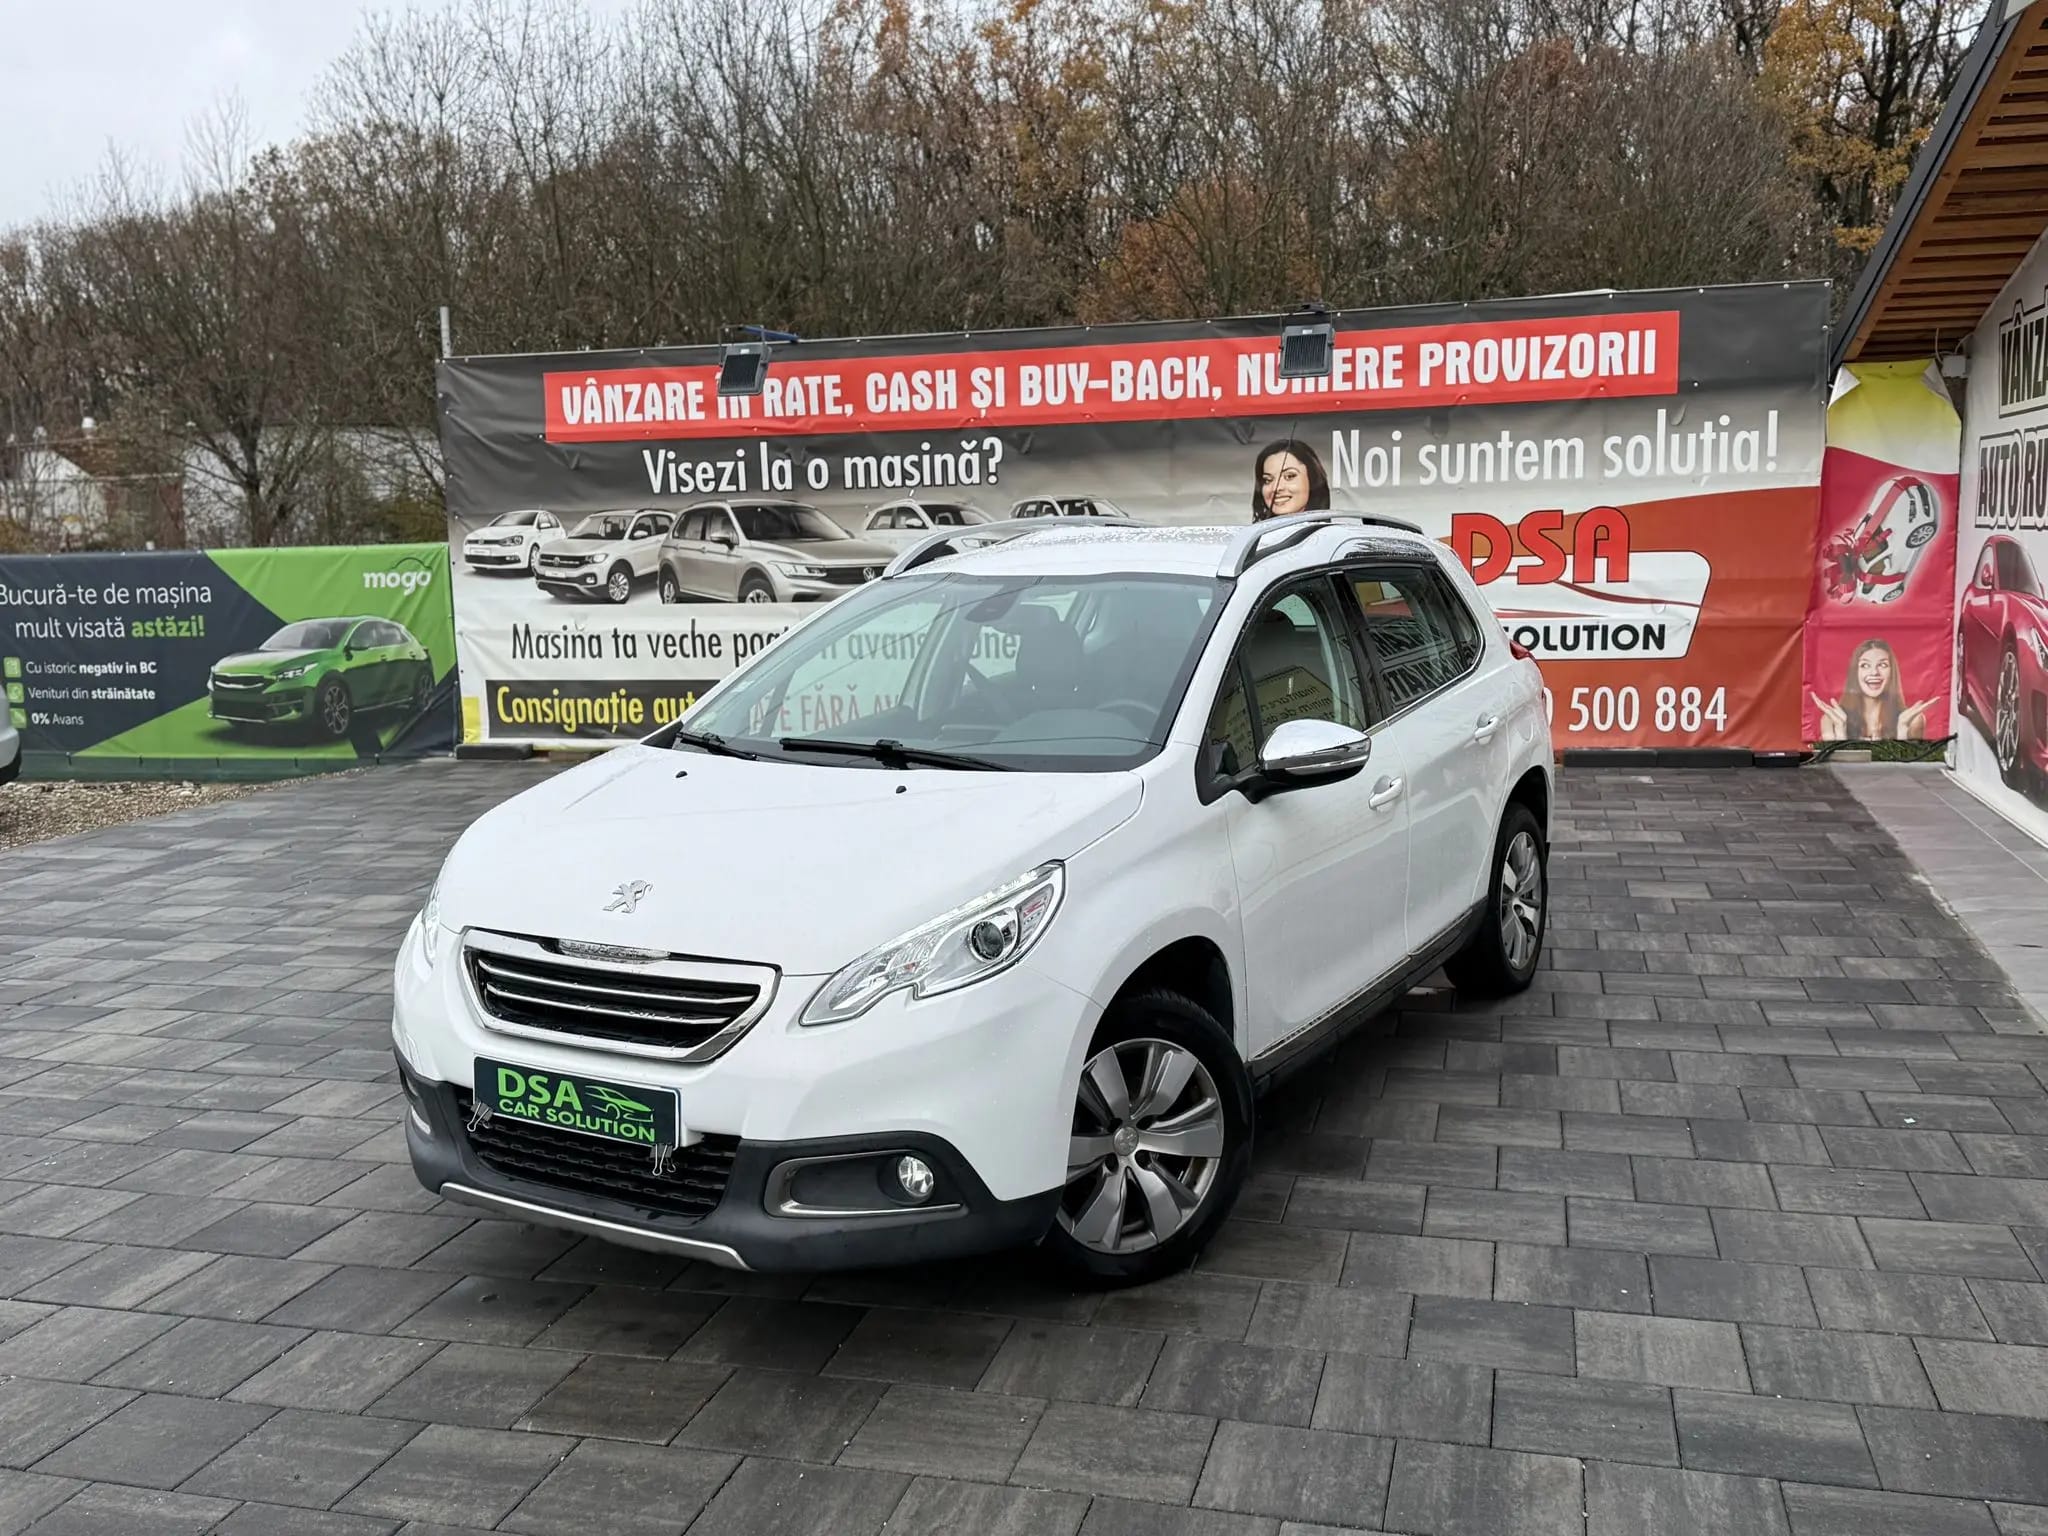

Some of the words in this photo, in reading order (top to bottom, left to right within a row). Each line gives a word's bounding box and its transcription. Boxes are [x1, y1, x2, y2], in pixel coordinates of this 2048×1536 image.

[562, 377, 705, 425] VÂNZARE
[763, 375, 854, 417] RATE,
[865, 369, 957, 414] CASH
[970, 367, 1005, 418] ȘI
[1419, 329, 1656, 387] PROVIZORII
[642, 449, 747, 494] Visezi
[760, 441, 793, 491] la
[807, 456, 829, 490] o
[1331, 429, 1402, 488] Noi
[1418, 430, 1584, 485] suntem
[1978, 440, 2021, 519] AUTO
[1452, 506, 1631, 586] DSA
[0, 583, 97, 605] Bucură-te
[103, 583, 130, 604] de
[136, 581, 212, 608] mașina
[363, 570, 432, 596] mogo
[16, 617, 62, 638] mult
[67, 616, 125, 638] visată
[131, 615, 205, 638] astăzi!
[611, 627, 637, 659] ta
[647, 618, 722, 659] veche
[1503, 623, 1666, 652] OLUTION
[26, 661, 42, 674] Cu
[43, 661, 77, 674] istoric
[79, 661, 123, 677] negativ
[140, 661, 157, 674] BC
[28, 687, 69, 700] Venituri
[72, 686, 89, 699] din
[91, 687, 156, 700] străinătate
[496, 686, 644, 733] Consignație
[1568, 686, 1640, 732] 500
[1655, 686, 1728, 732] 884
[31, 713, 50, 725] 0%
[52, 713, 84, 726] Avans
[497, 1067, 583, 1111] DSA
[499, 1099, 540, 1119] CAR
[546, 1108, 655, 1142] SOLUTION
